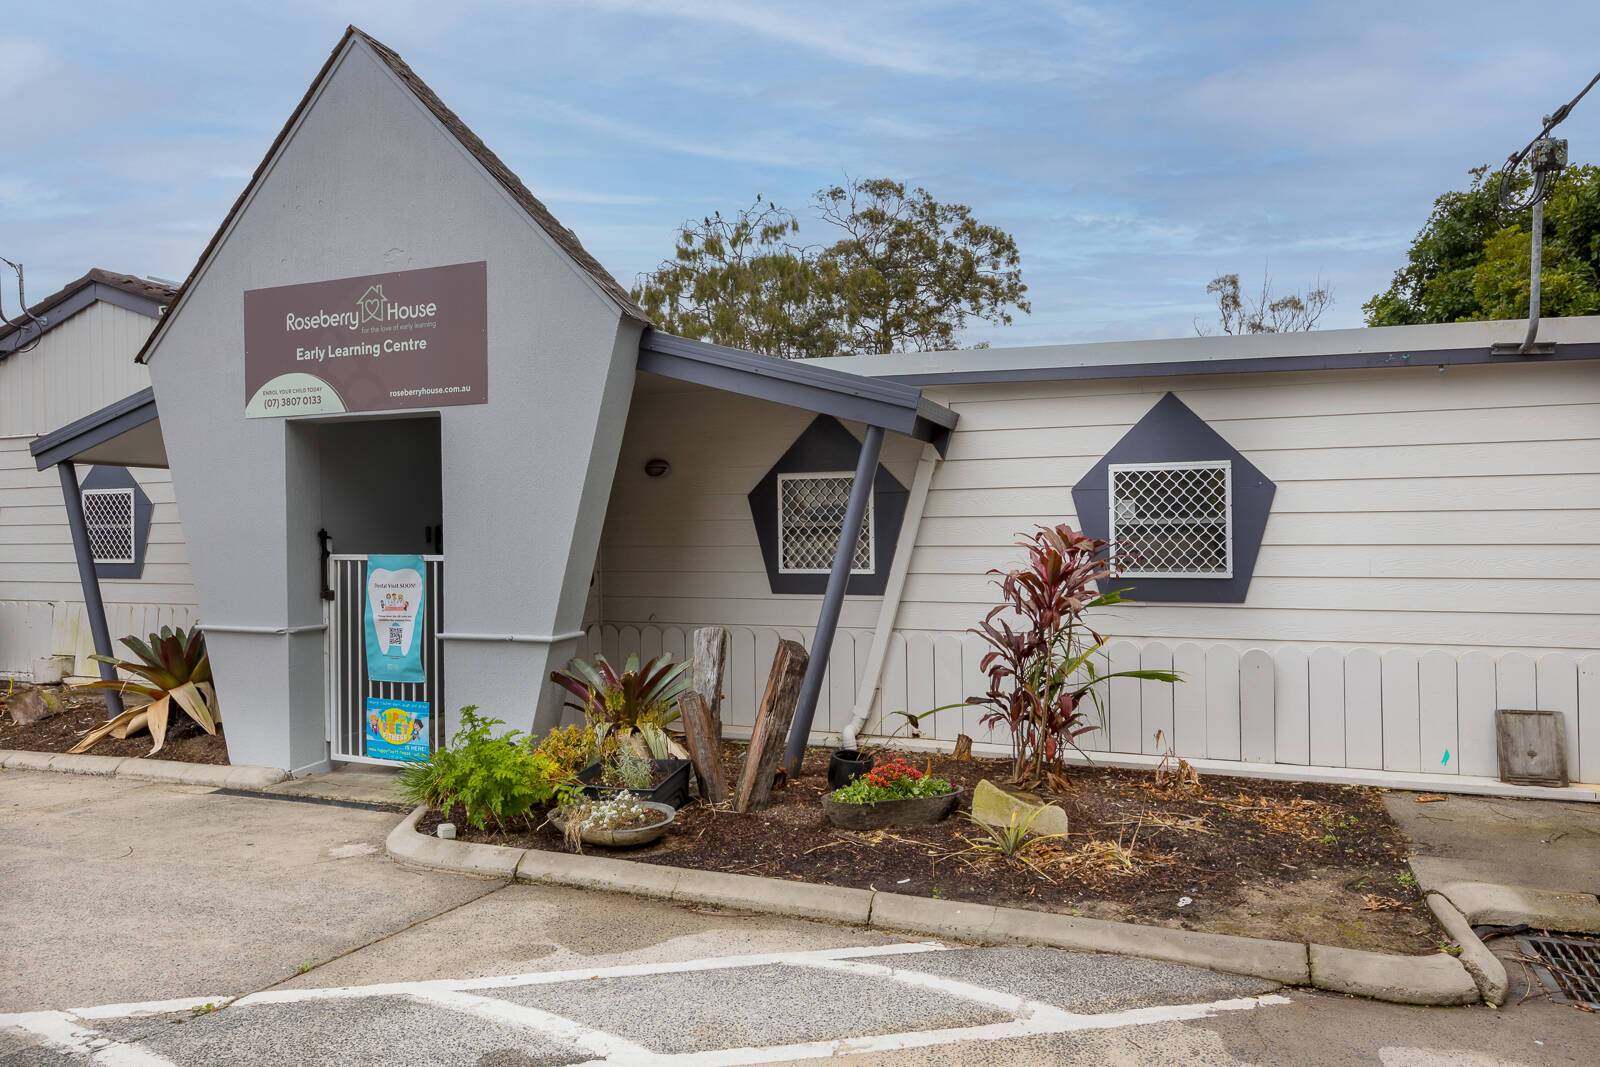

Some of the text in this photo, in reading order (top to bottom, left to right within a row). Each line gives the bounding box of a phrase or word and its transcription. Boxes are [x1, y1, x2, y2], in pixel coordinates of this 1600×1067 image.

[286, 302, 437, 332] Roseberry House
[400, 323, 413, 331] early
[414, 321, 437, 329] learning
[296, 338, 427, 362] Early Learning Centre
[389, 385, 471, 398] roseberryhouse.com.au
[264, 395, 322, 409] (07) 3807 0133
[382, 723, 409, 734] FEET
